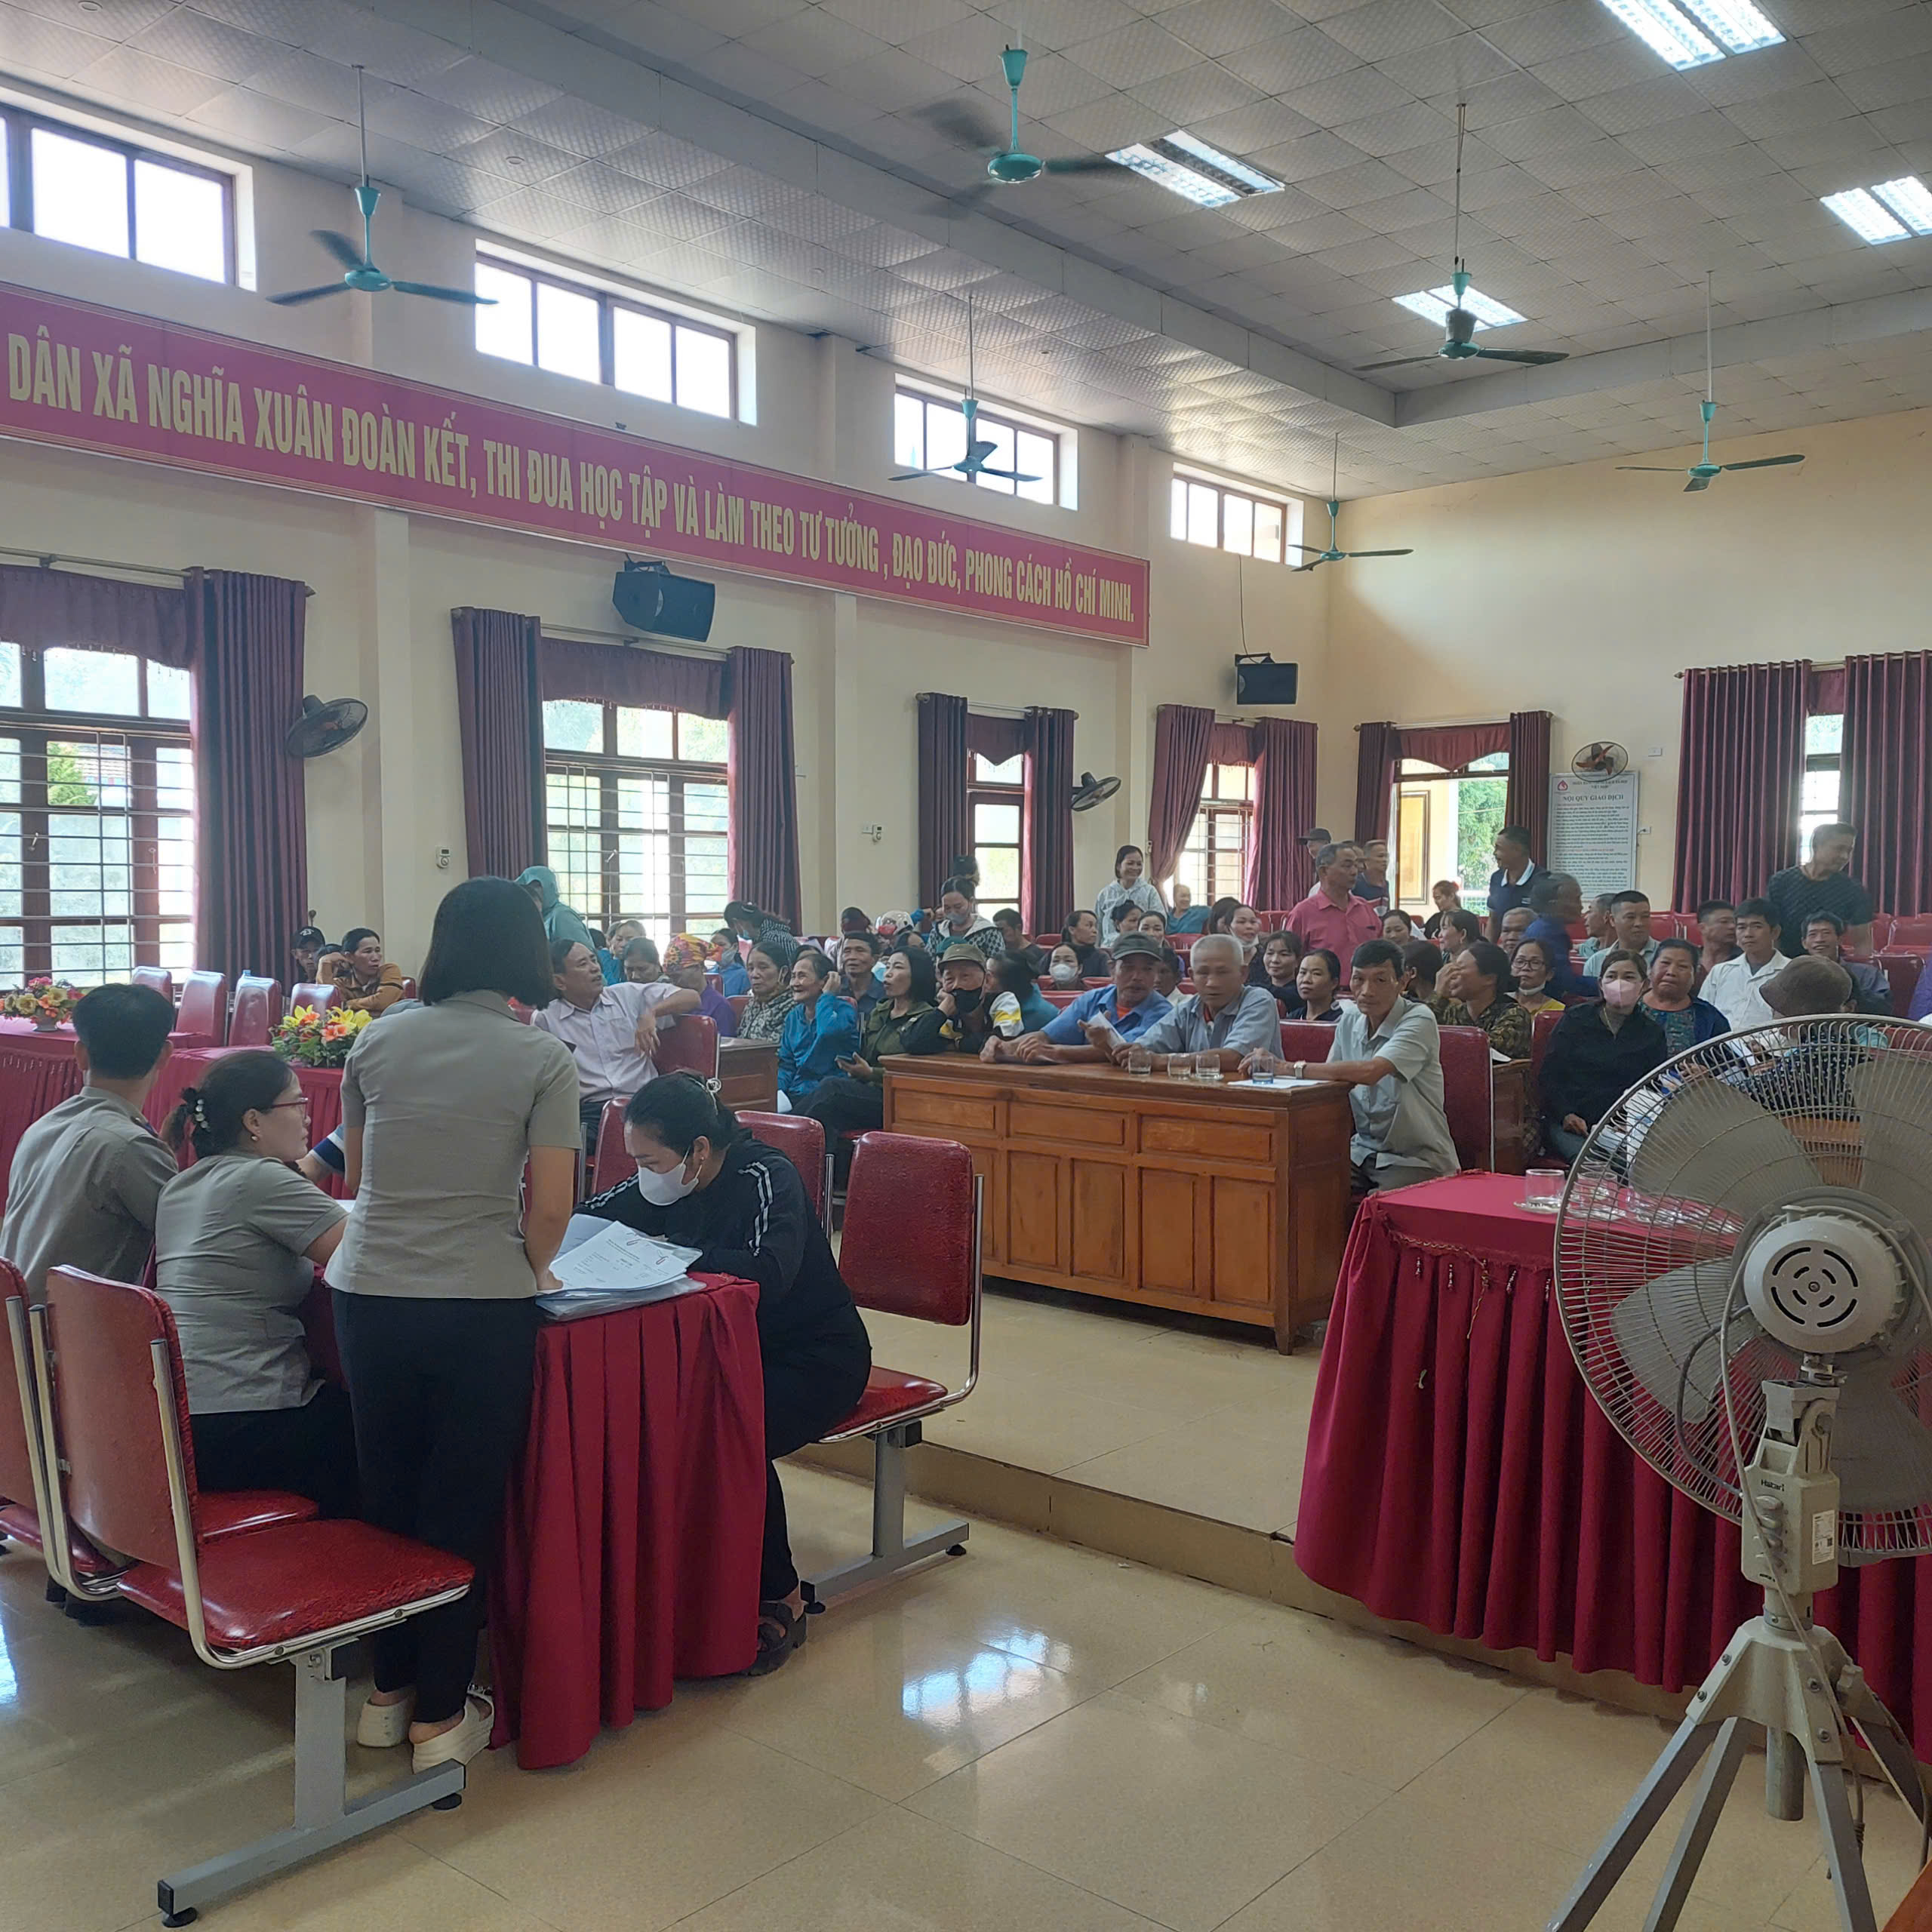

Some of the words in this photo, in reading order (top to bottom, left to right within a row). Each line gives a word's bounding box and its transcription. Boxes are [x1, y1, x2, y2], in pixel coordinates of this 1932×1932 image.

[8, 325, 82, 412] DÂN
[91, 344, 138, 423] XÃ
[148, 364, 246, 445] NGHĨA
[254, 384, 334, 462] XUÂN
[341, 403, 415, 478] ĐOÀN
[423, 411, 476, 498] KẾT,
[483, 439, 520, 500] THI
[528, 449, 574, 511] ĐUA
[580, 461, 623, 530] HỌC
[629, 465, 667, 538] TẬP
[673, 475, 699, 536] VÀ
[705, 481, 745, 545] LÀM
[750, 500, 795, 555] THEO
[799, 510, 823, 560] TƯ
[893, 533, 923, 589] ĐẠO
[928, 531, 961, 595] ĐỨC,
[965, 549, 1013, 598] PHONG
[1016, 554, 1051, 606] CÁCH
[1054, 557, 1072, 611] HỒ
[1075, 568, 1096, 615] CHÍ
[1100, 579, 1134, 622] MINH.
[1761, 1479, 1784, 1491] Hatari
